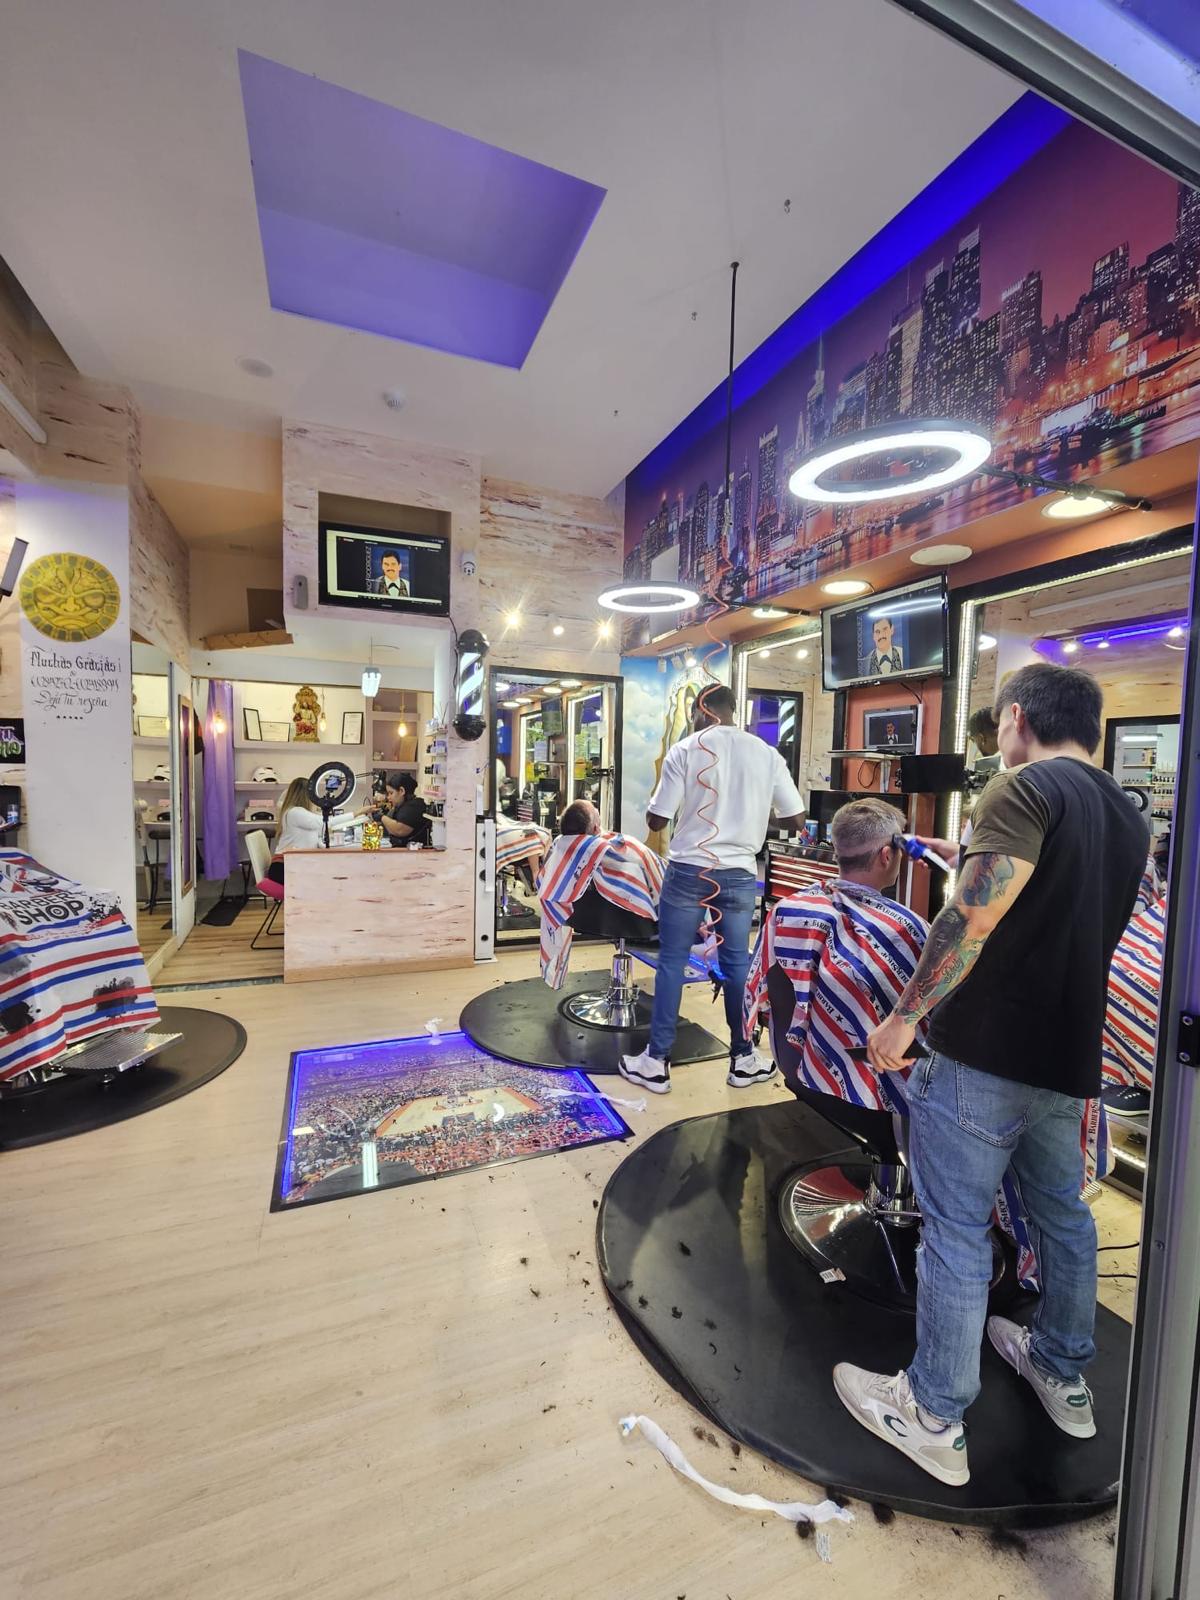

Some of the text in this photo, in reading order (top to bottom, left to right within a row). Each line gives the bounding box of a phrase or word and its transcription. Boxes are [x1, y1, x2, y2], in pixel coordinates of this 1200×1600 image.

[31, 647, 73, 669] Muchas
[0, 892, 76, 912] BARBER
[13, 900, 84, 925] SHOP
